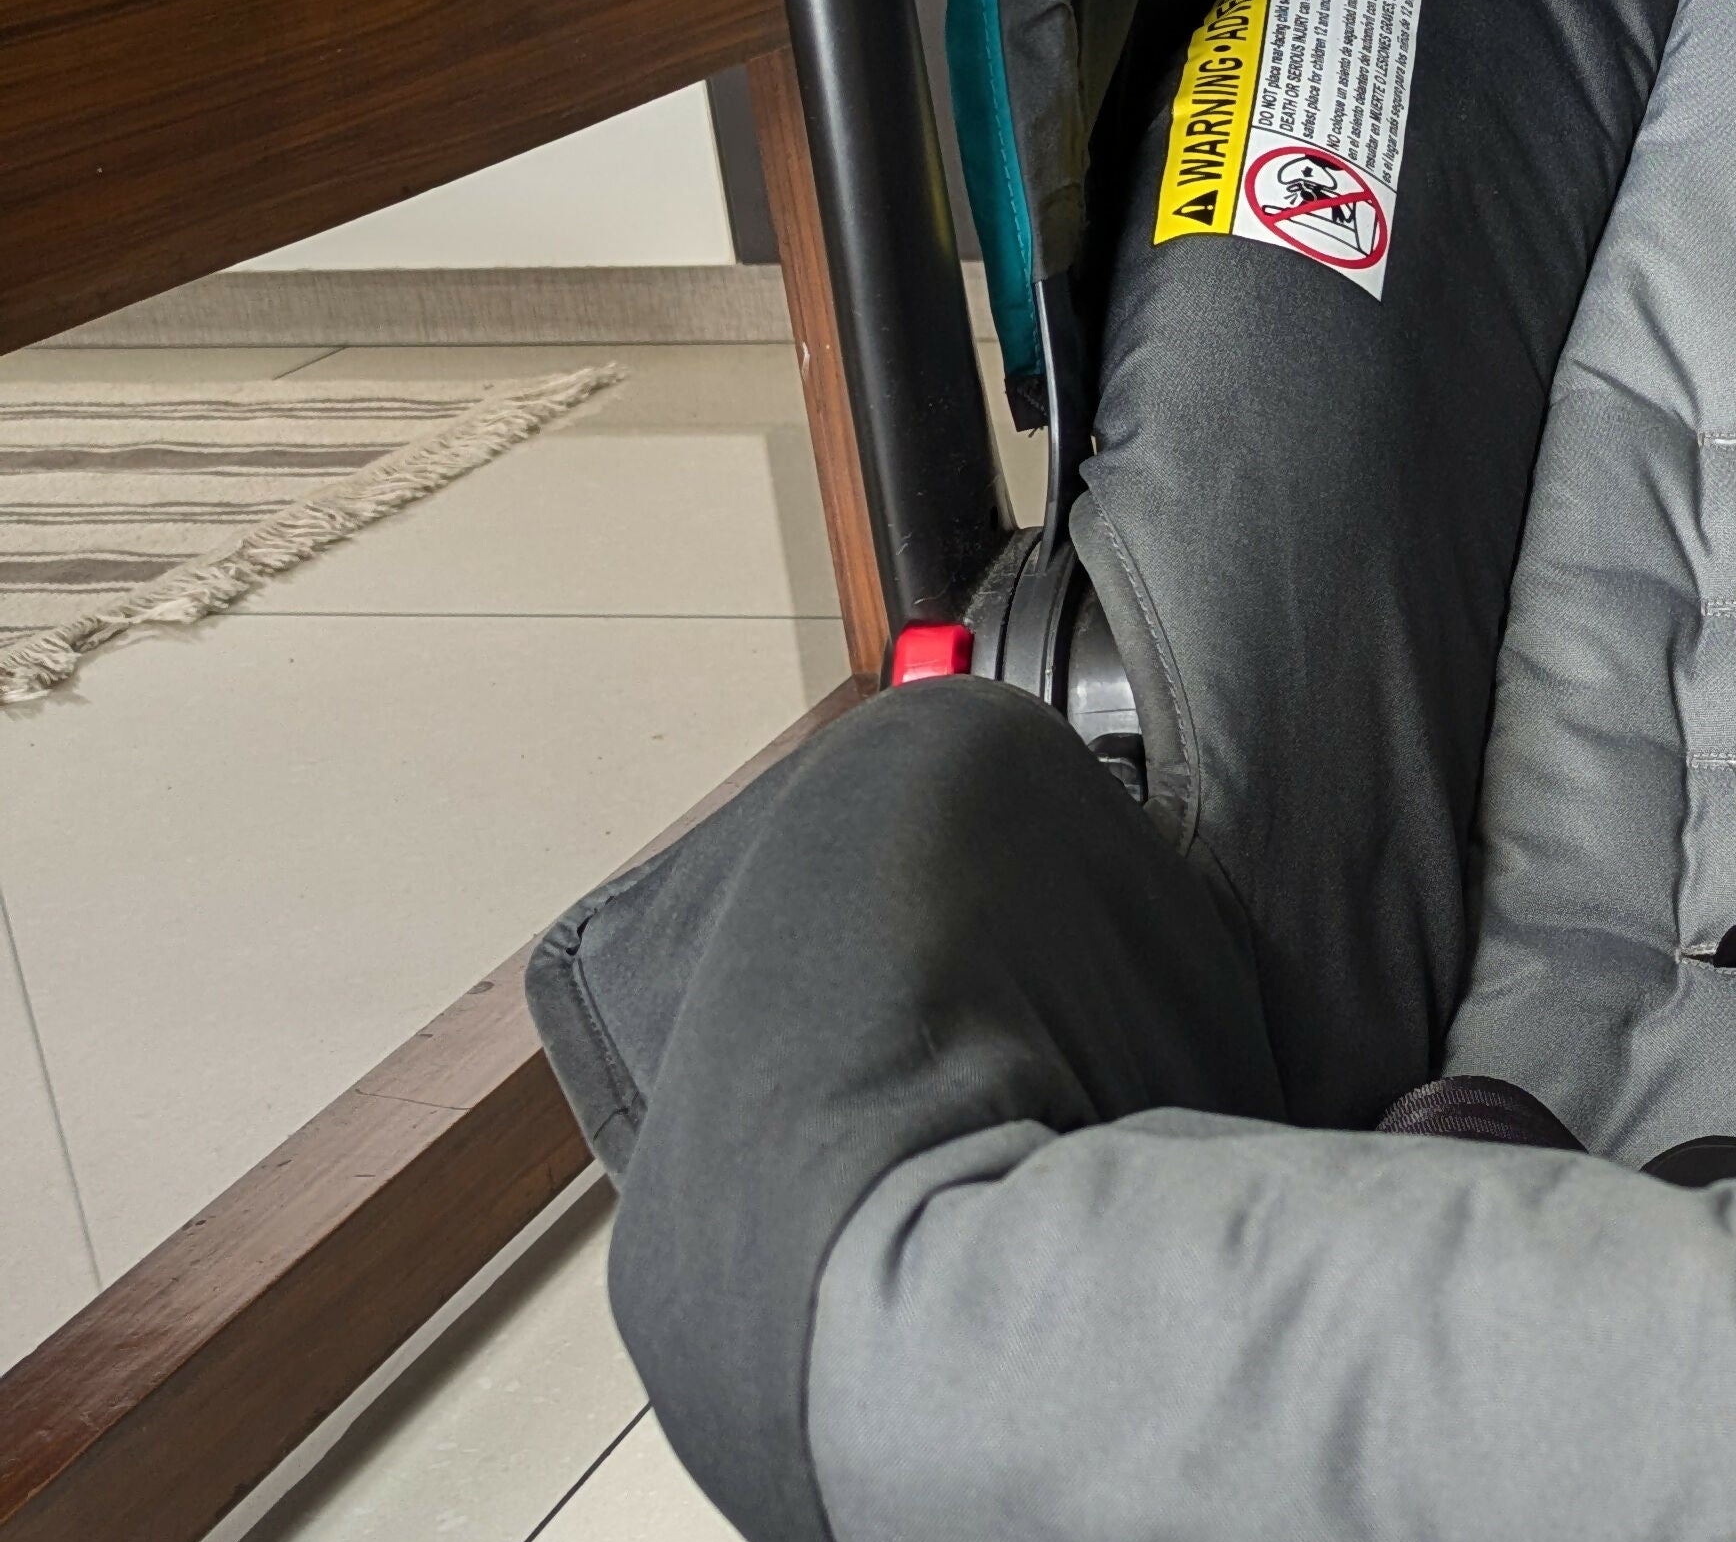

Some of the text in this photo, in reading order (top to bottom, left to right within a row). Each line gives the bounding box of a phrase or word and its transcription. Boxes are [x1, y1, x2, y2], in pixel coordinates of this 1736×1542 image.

[1274, 5, 1289, 22] child
[1298, 1, 1310, 14] can
[1365, 1, 1377, 15] con
[1400, 6, 1412, 18] 12
[1292, 14, 1308, 44] INJURY
[1317, 11, 1330, 27] and
[1341, 9, 1357, 46] seguridad
[1399, 18, 1410, 30] de
[1313, 26, 1328, 37] 12
[1358, 14, 1376, 53] automóvil
[1396, 30, 1409, 53] niños
[1269, 24, 1291, 65] rear-facing
[1310, 38, 1326, 71] children
[1339, 47, 1352, 57] de
[1286, 45, 1305, 83] SERIOUS
[1356, 52, 1371, 66] del
[1375, 34, 1391, 77] LESIONES
[1395, 54, 1407, 68] los
[1265, 66, 1282, 88] place
[1308, 73, 1322, 85] for
[1337, 57, 1351, 88] asiento
[1374, 77, 1386, 85] O
[1394, 68, 1406, 90] para
[1284, 83, 1301, 98] OR
[1336, 88, 1347, 99] un
[1353, 67, 1369, 105] delantero
[1261, 88, 1277, 109] NOT
[1305, 85, 1321, 110] place
[1369, 83, 1384, 121] MUERTE
[1390, 88, 1404, 118] seguro
[1176, 58, 1243, 187] WARNING
[1258, 111, 1274, 126] DO
[1280, 99, 1298, 132] DEATH
[1301, 110, 1317, 139] safest
[1330, 100, 1347, 135] coloque
[1349, 106, 1365, 138] asiento
[1370, 123, 1381, 136] en
[1386, 117, 1399, 138] más
[1325, 135, 1341, 151] NO
[1347, 136, 1359, 148] el
[1383, 138, 1399, 161] lugar
[1347, 148, 1358, 160] en
[1365, 135, 1379, 171] resultar
[1382, 160, 1392, 171] el
[1382, 172, 1392, 184] es
